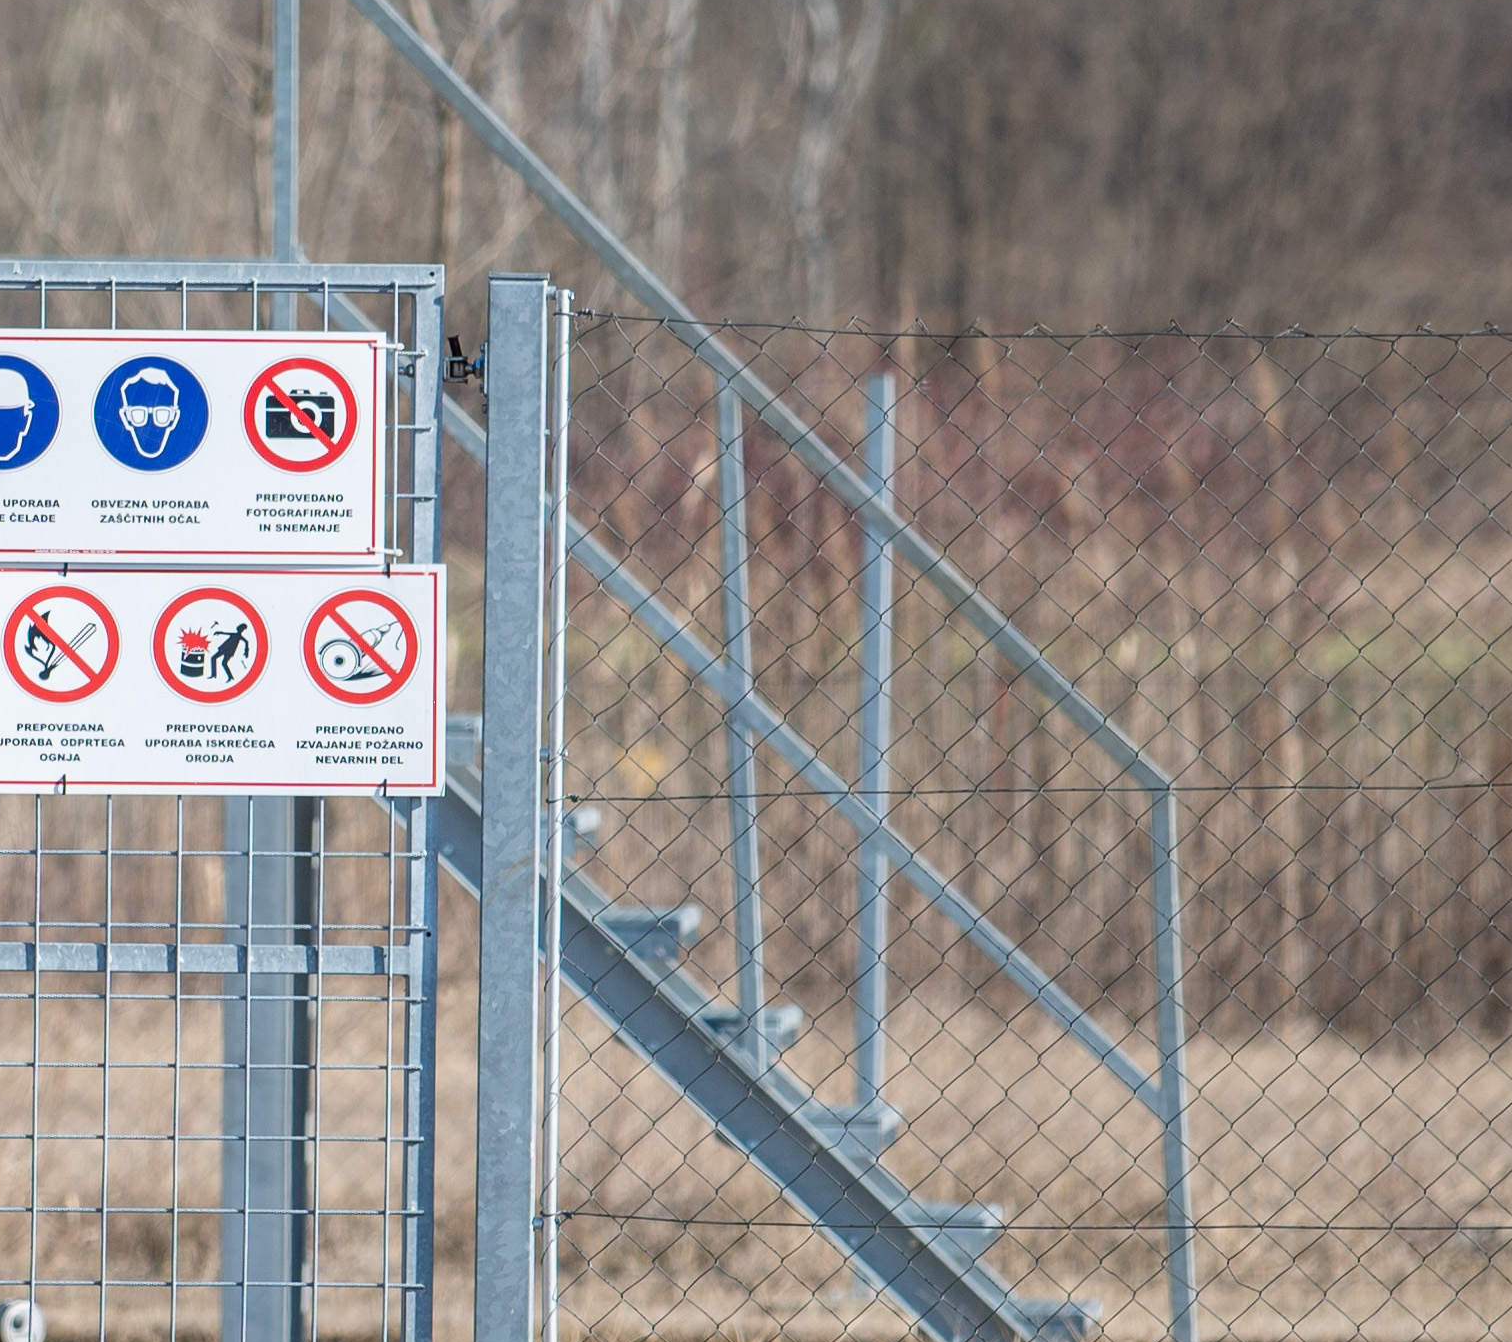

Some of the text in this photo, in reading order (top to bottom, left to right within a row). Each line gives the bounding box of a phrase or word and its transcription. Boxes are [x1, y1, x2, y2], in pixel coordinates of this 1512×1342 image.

[2, 498, 61, 508] UPORABA
[255, 493, 344, 503] PREPOVEDANO
[91, 499, 210, 510] OBVEZNA UPORABA
[9, 512, 56, 523] ČELADE
[246, 508, 353, 518] FOTOGRAFIRANJE
[99, 513, 201, 524] ZAŠČITNIH OČAL
[259, 523, 340, 533] IN SNEMANJE
[16, 722, 105, 732] PREPOVEDANA
[166, 723, 255, 734] PREPOVEDANA
[315, 725, 405, 735] PREPOVEDANO
[60, 738, 125, 748] ODPRTEGA
[144, 738, 203, 748] UPORABA
[296, 739, 424, 750] IZVAJANJE POŽARNO
[39, 753, 81, 762] OGNJA
[185, 754, 234, 763] ORODJA
[315, 755, 404, 765] NEVARNIH DEL
